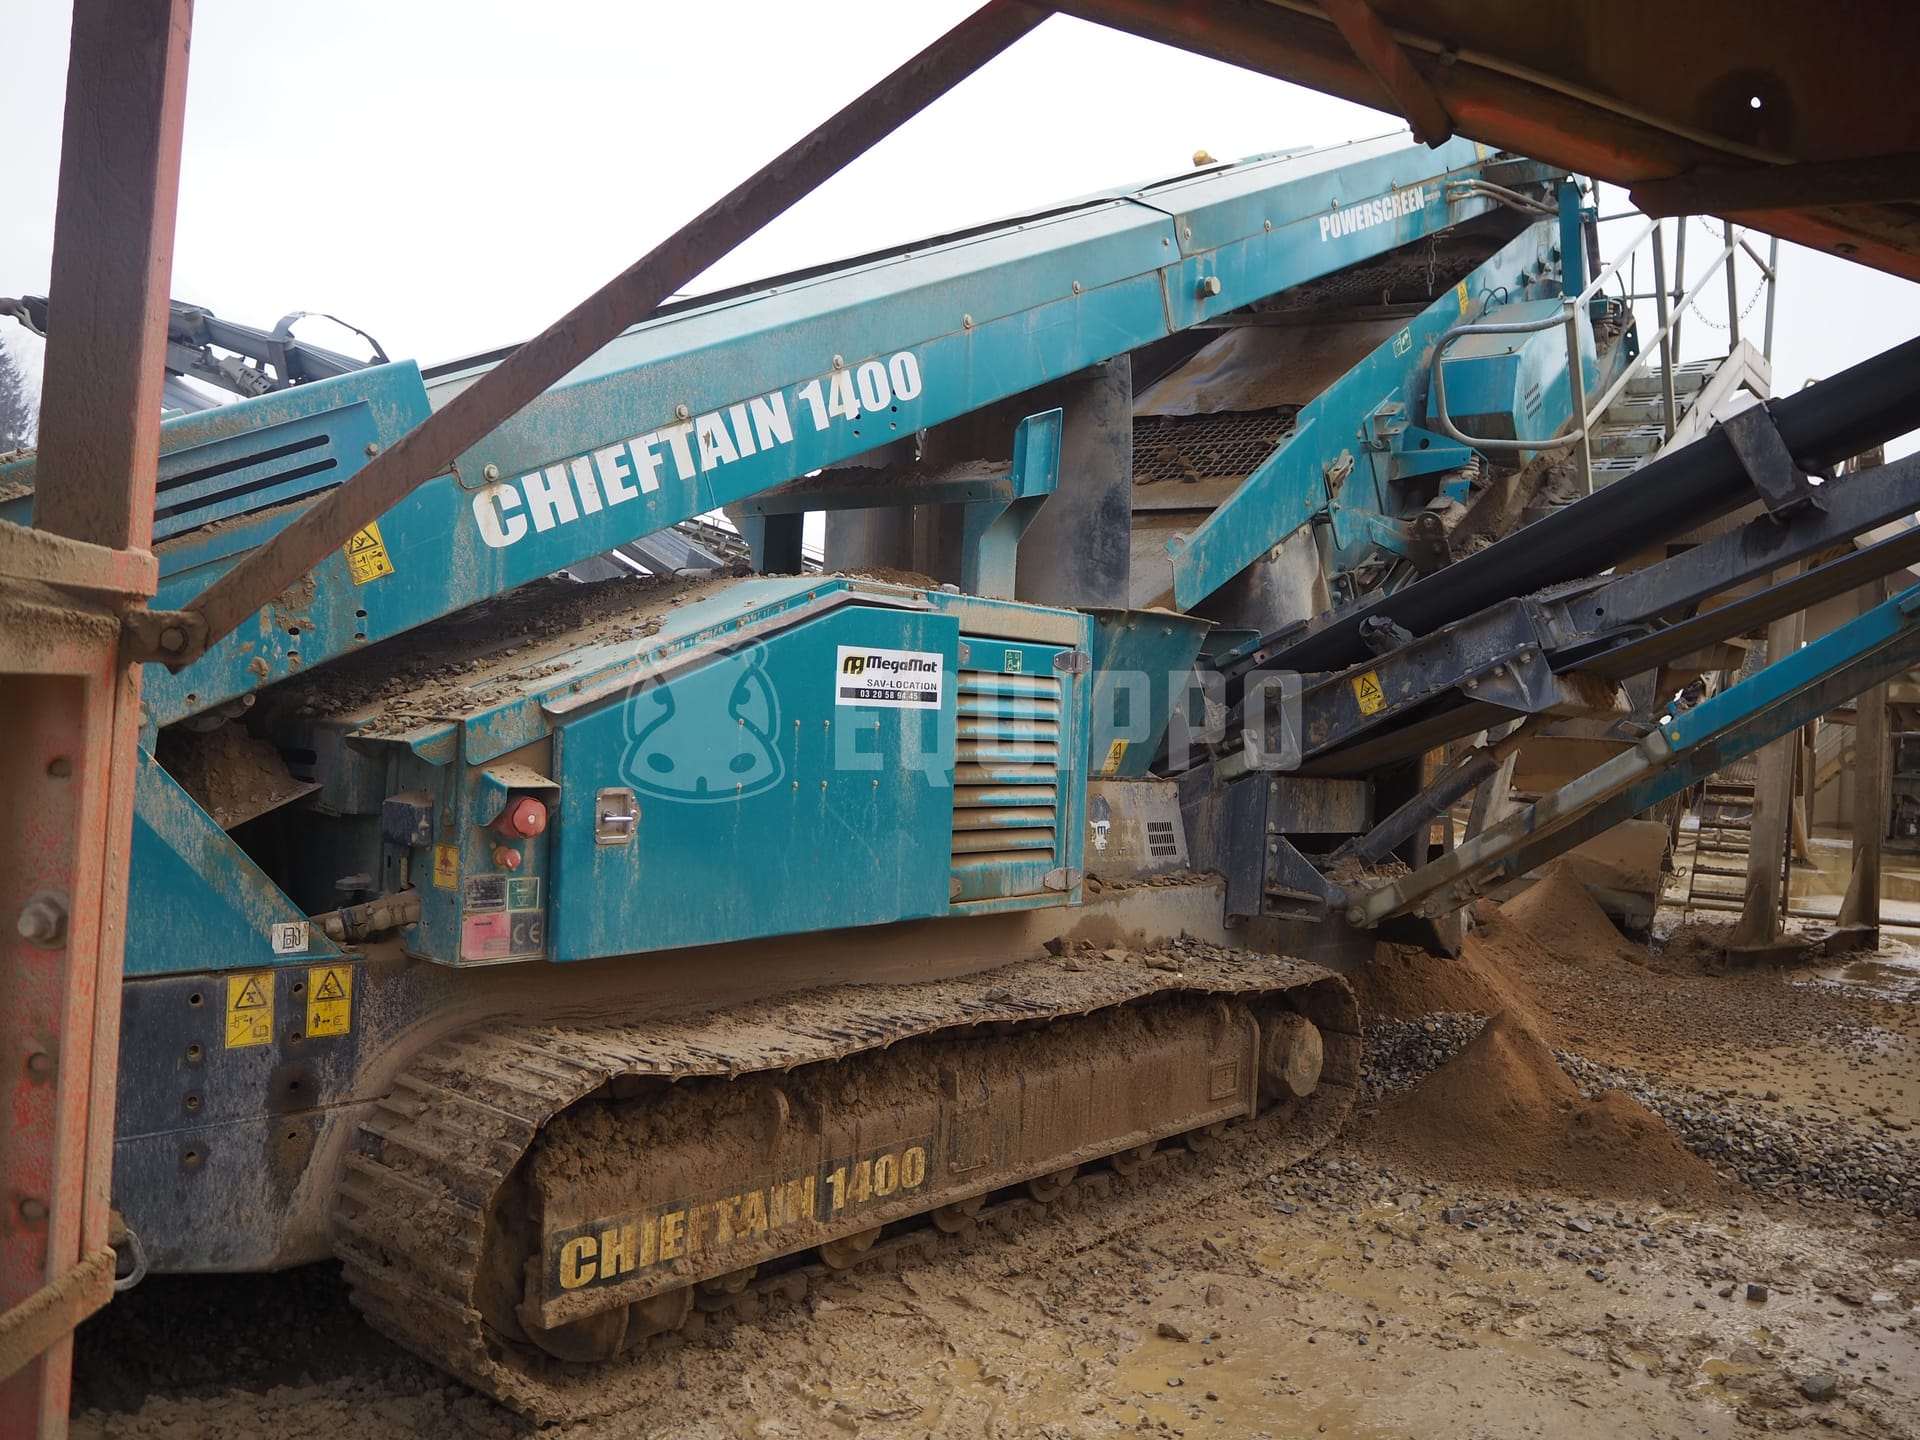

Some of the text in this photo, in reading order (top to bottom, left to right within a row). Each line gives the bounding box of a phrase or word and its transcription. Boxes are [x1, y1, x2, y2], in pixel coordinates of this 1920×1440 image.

[1319, 186, 1425, 242] POWERSCREEN
[472, 351, 922, 548] CHIEFTAIN 1400
[866, 656, 937, 674] MegaMat
[860, 690, 870, 698] 03
[872, 690, 882, 698] 20
[867, 679, 937, 690] SAV-LOCATION
[559, 1146, 926, 1289] CHIEFTAIN 1400
